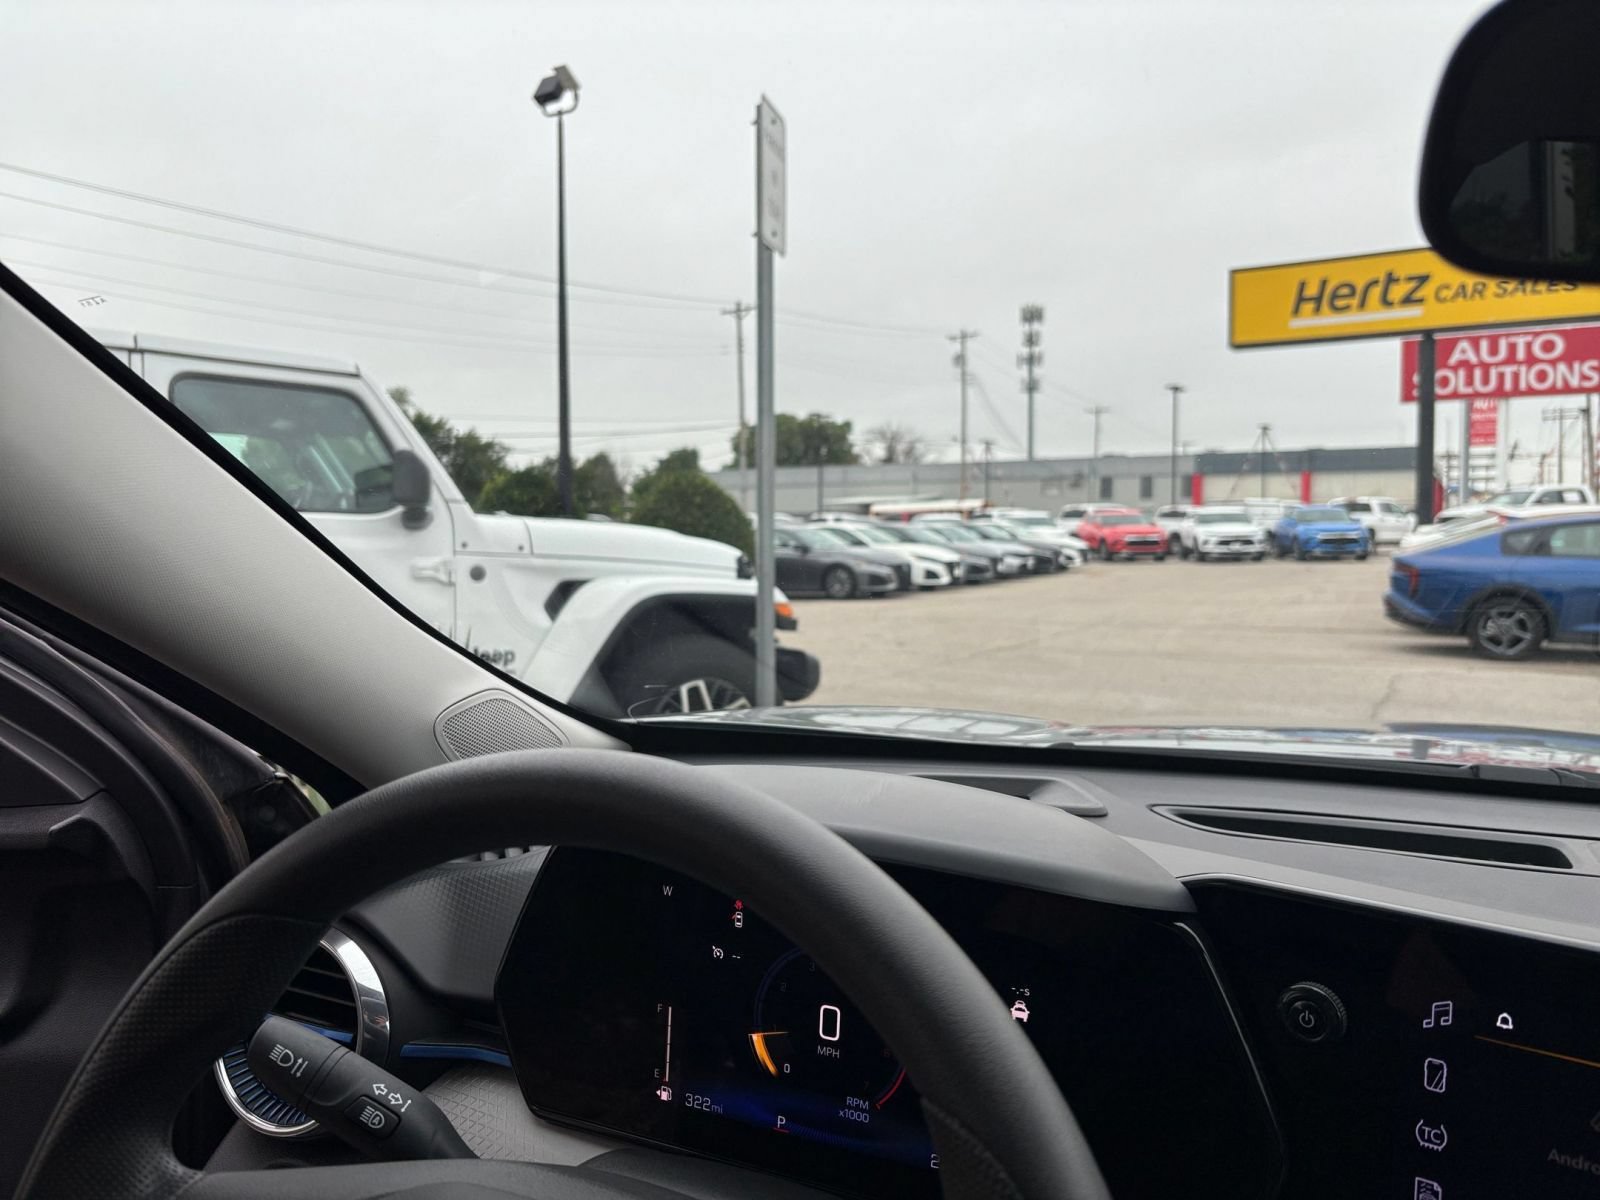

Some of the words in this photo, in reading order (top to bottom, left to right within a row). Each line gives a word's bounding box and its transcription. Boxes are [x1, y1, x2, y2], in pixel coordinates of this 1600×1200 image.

[1292, 270, 1431, 317] Hertz
[1434, 281, 1487, 303] CAR
[1448, 332, 1566, 366] AUTO
[662, 884, 674, 897] W
[657, 1002, 664, 1013] F
[818, 1004, 841, 1042] 0
[816, 1045, 841, 1059] MPH
[653, 1067, 661, 1079] E
[845, 1095, 870, 1111] RPM
[776, 1114, 787, 1129] P
[838, 1108, 871, 1124] x1000
